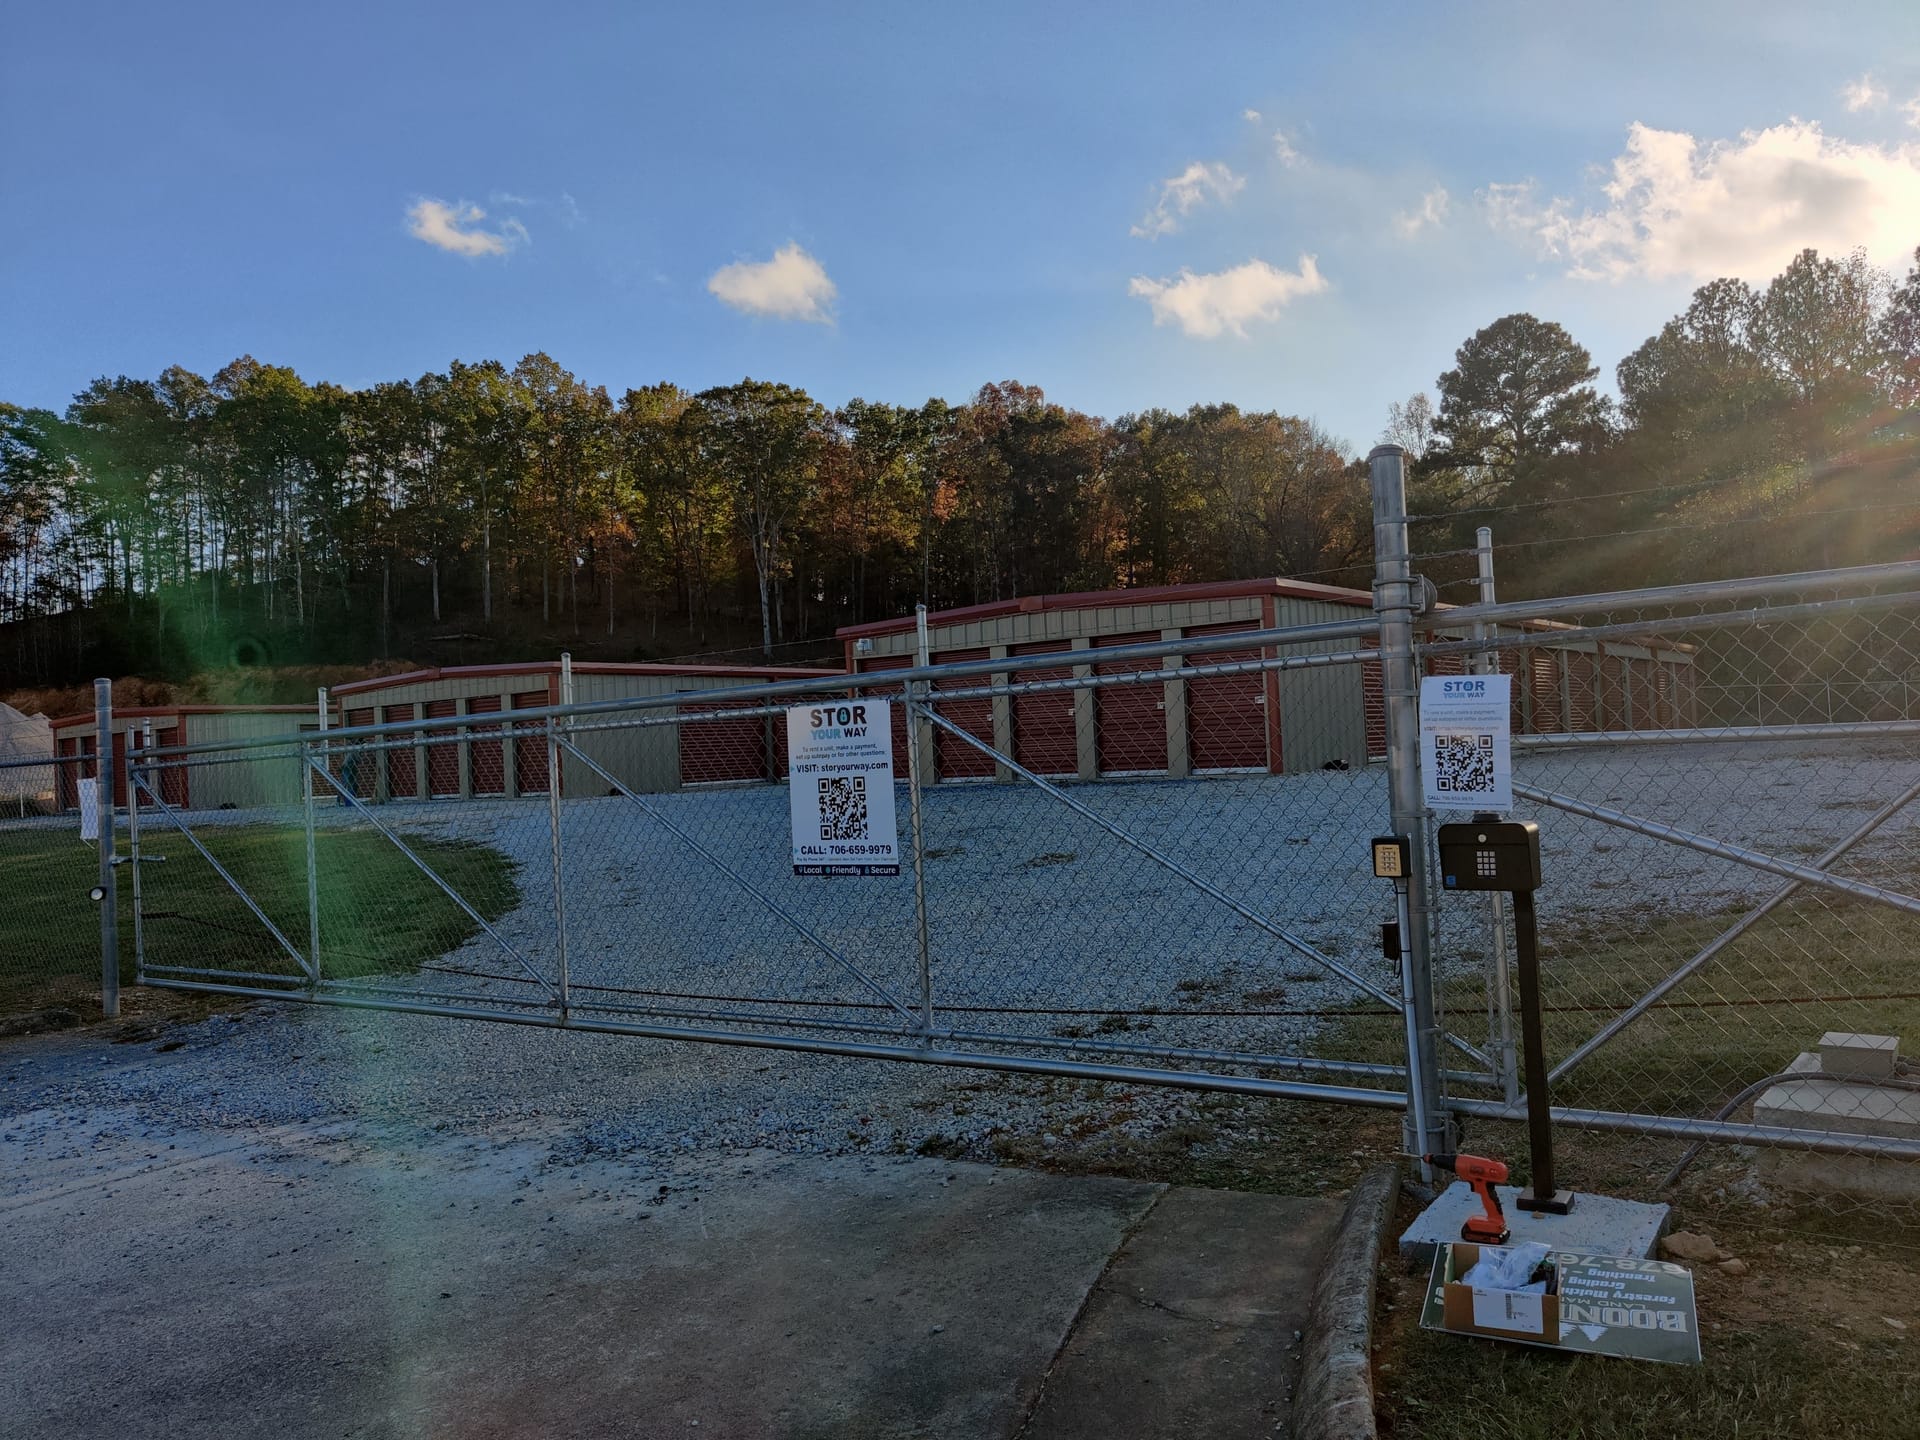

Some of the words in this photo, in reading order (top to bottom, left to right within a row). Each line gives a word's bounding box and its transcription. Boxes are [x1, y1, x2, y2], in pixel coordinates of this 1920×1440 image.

[1443, 680, 1485, 692] STOR
[810, 705, 867, 728] STOR
[811, 728, 840, 740] YOUR
[843, 727, 867, 738] WAY
[854, 743, 878, 751] payment,
[796, 764, 819, 774] VISIT:
[821, 761, 889, 774] storyourway.com
[800, 845, 827, 855] CALL:
[829, 844, 892, 855] 706-659-9979
[803, 866, 823, 874] Local
[831, 866, 861, 875] Friendly
[870, 866, 896, 874] Secure
[1588, 1267, 1656, 1283] Trenching
[1568, 1276, 1625, 1290] Grading
[1612, 1291, 1676, 1305] Forestry
[1598, 1300, 1646, 1310] LAND
